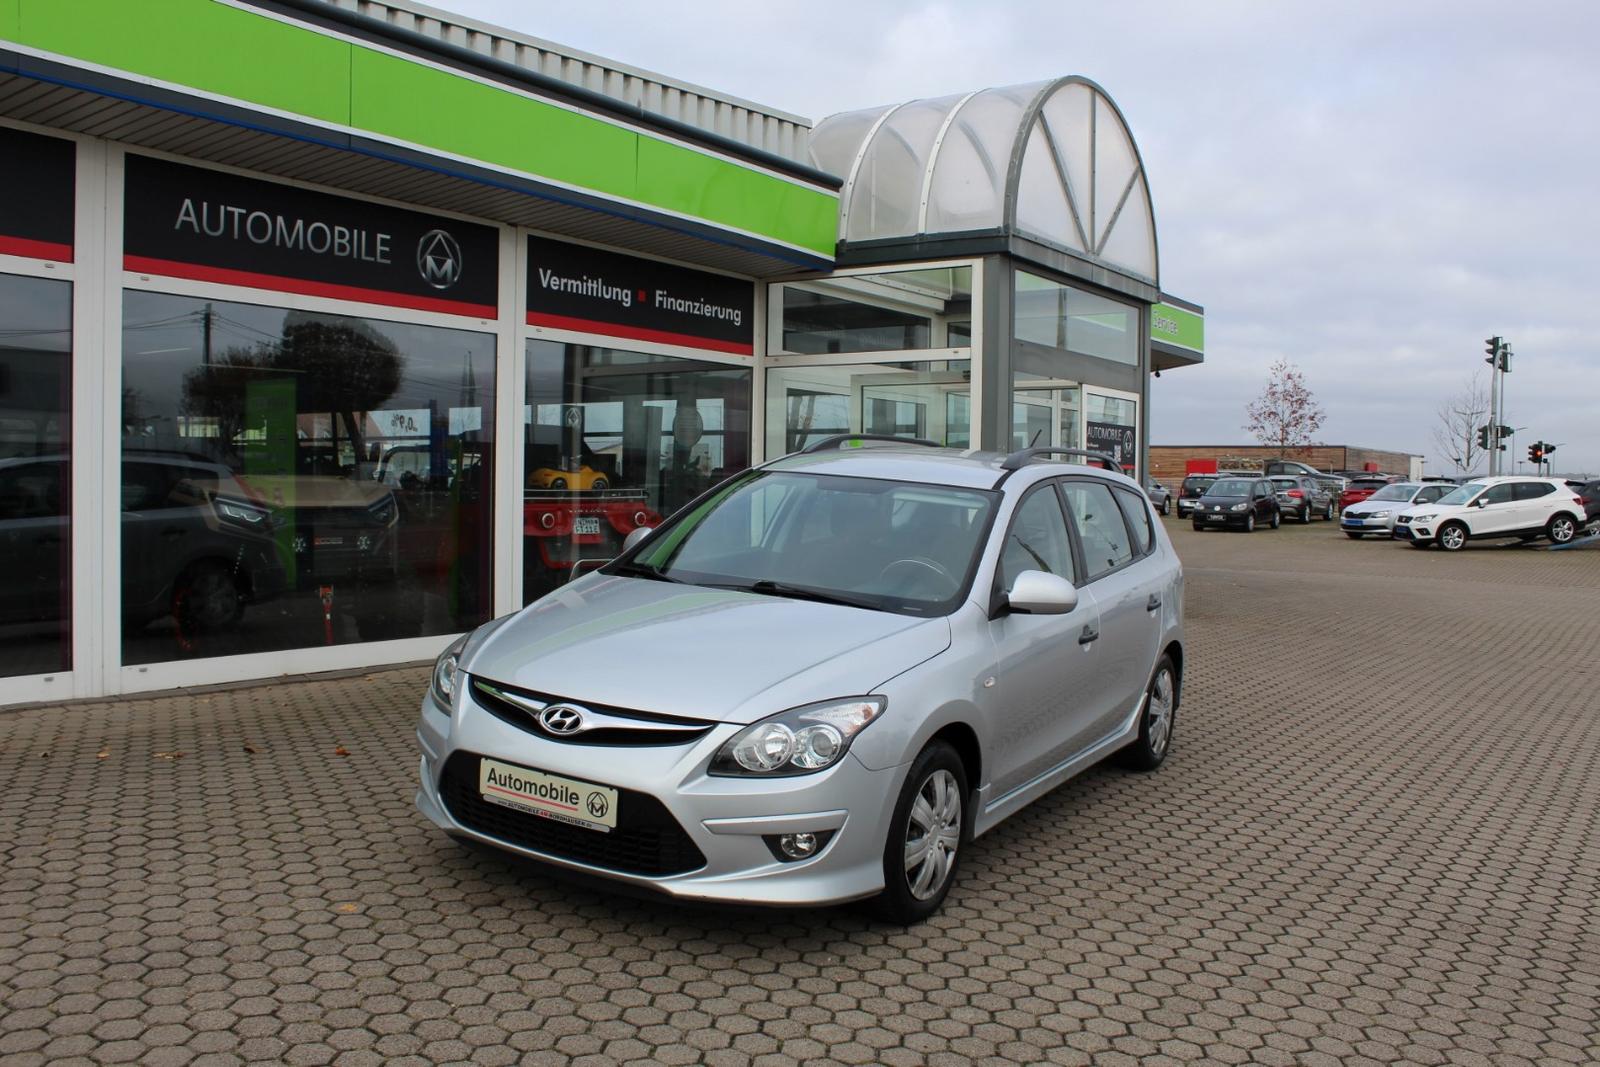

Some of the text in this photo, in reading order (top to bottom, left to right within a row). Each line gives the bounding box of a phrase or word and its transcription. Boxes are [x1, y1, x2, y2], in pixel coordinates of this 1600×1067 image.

[174, 198, 392, 265] AUTOMOBILE
[538, 267, 742, 326] Vermittlung Finanzierung
[1087, 426, 1122, 441] AUTOMOBILE
[487, 767, 580, 806] Automobile
